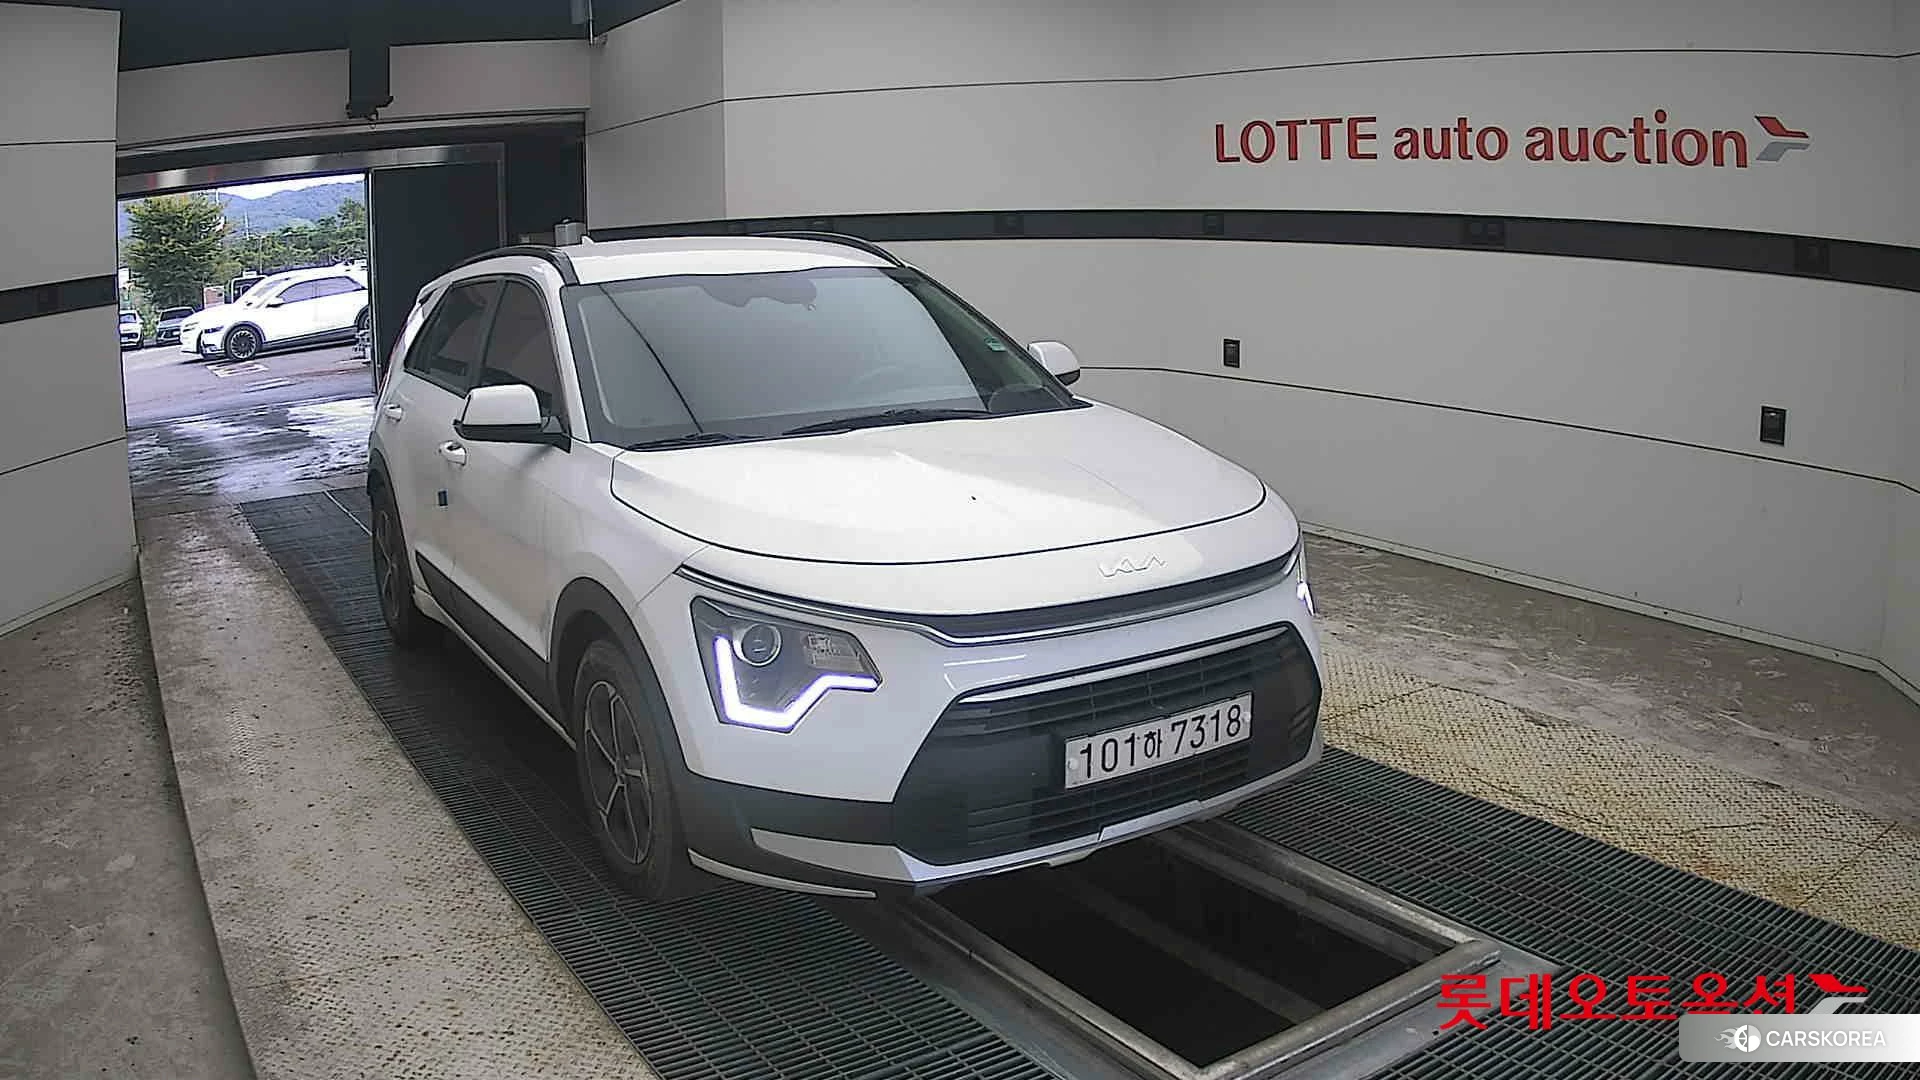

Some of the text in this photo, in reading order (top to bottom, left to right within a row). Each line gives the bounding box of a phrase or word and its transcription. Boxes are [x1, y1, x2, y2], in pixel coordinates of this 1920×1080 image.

[1214, 108, 1749, 169] LOTTE auto auction
[1079, 703, 1242, 779] 101하 7318
